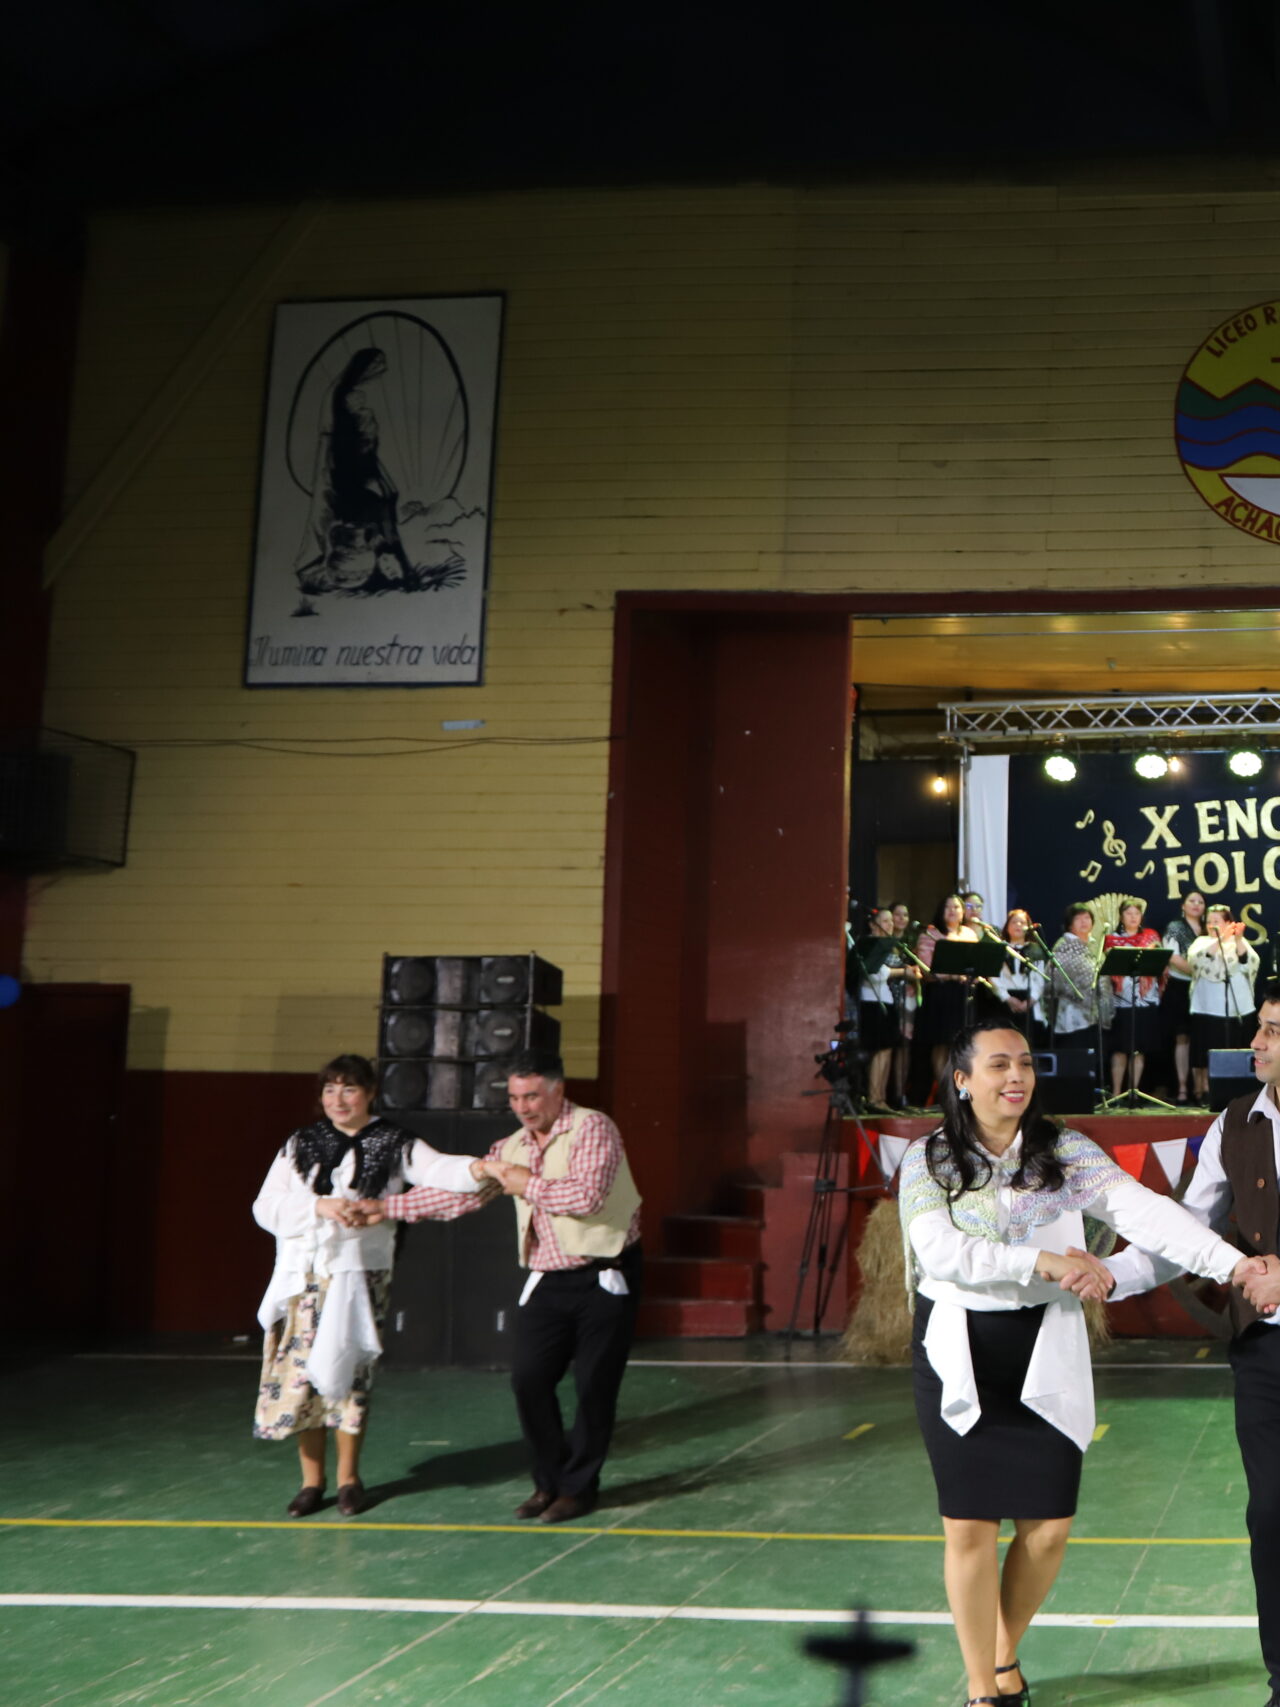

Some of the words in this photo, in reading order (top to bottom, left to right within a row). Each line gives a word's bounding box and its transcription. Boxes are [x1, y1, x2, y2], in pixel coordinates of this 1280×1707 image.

[1205, 314, 1258, 359] LICEO
[335, 634, 423, 667] nuestra
[432, 633, 476, 666] vida
[1140, 804, 1182, 850] X
